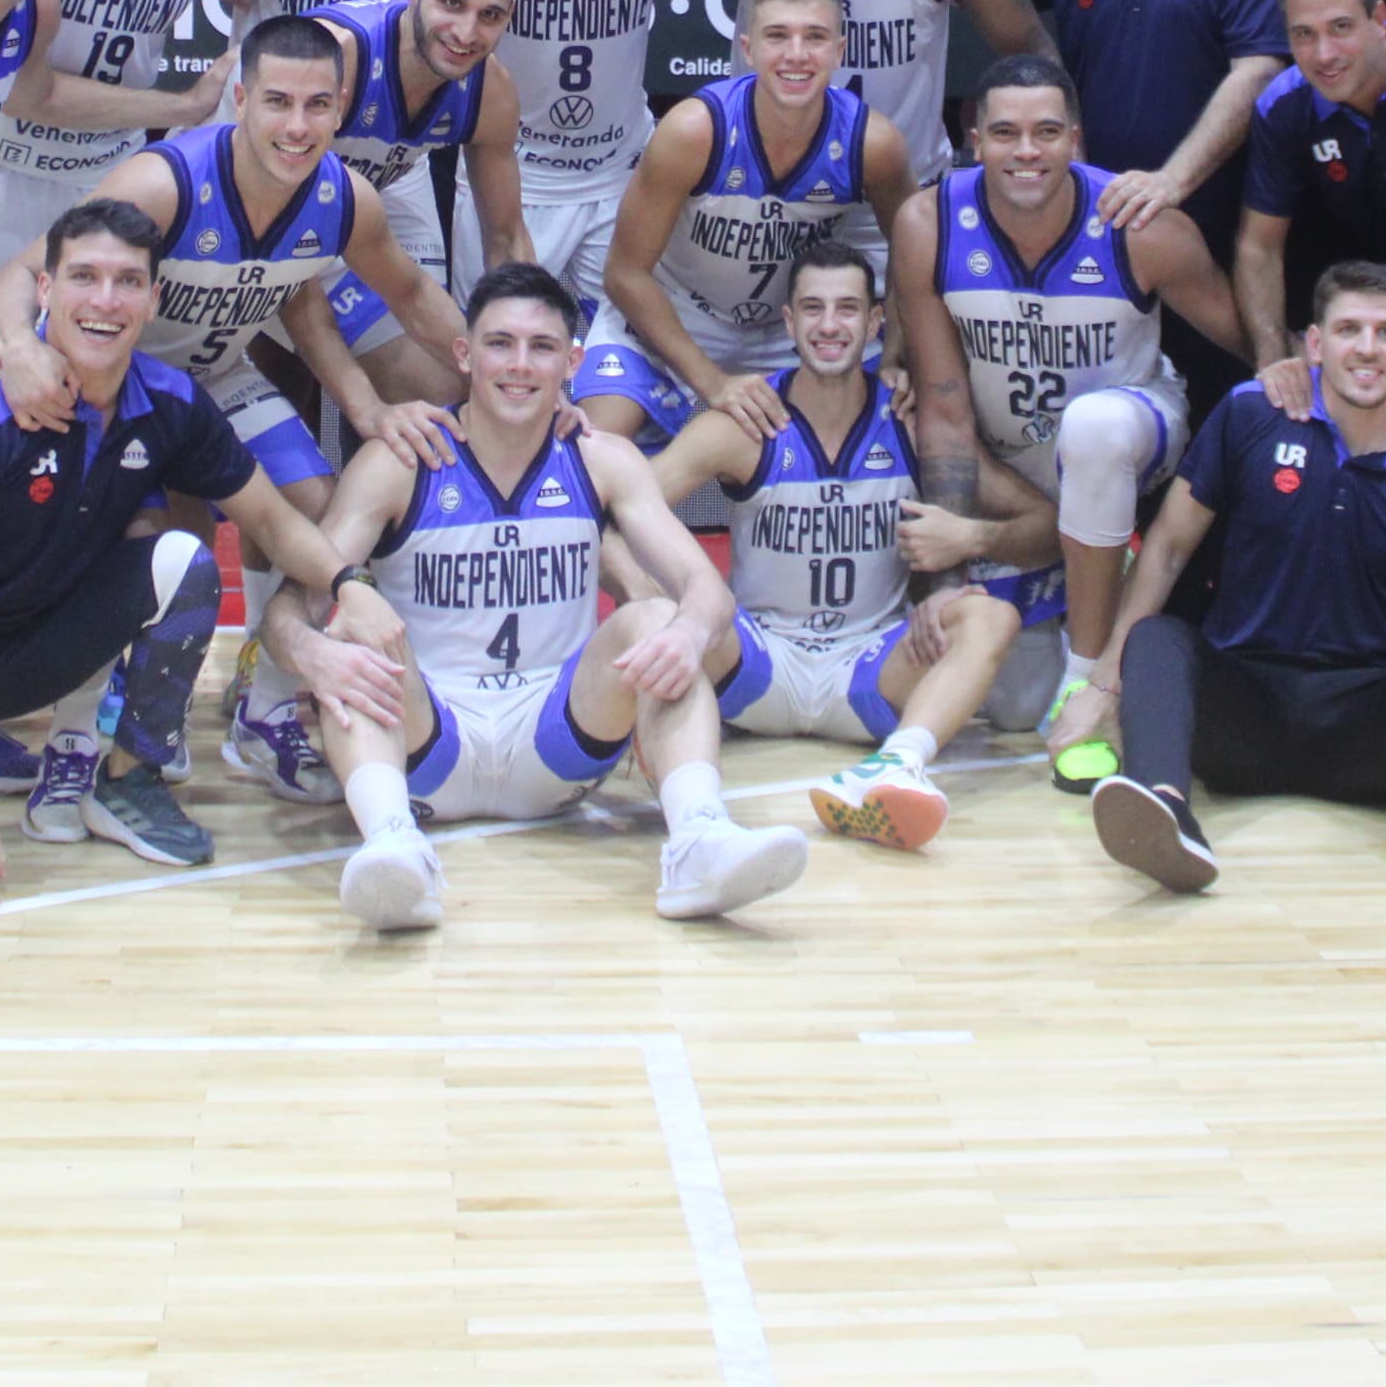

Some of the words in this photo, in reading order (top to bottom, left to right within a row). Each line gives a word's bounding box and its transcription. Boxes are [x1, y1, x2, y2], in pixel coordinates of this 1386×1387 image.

[558, 44, 594, 93] 8
[669, 56, 732, 77] Calida
[1312, 138, 1343, 163] UR
[759, 200, 784, 221] UR
[237, 265, 266, 285] UR
[748, 262, 779, 300] 7
[332, 286, 364, 315] UR
[1018, 300, 1044, 322] UR
[189, 328, 239, 365] 5
[1007, 370, 1067, 420] 22
[1274, 442, 1308, 469] UR
[819, 484, 846, 505] UR
[493, 525, 521, 548] UR
[751, 500, 899, 555] INDEPENDIENT
[413, 541, 592, 610] INDEPENDIENTE
[808, 557, 856, 608] 10
[486, 612, 521, 670] 4
